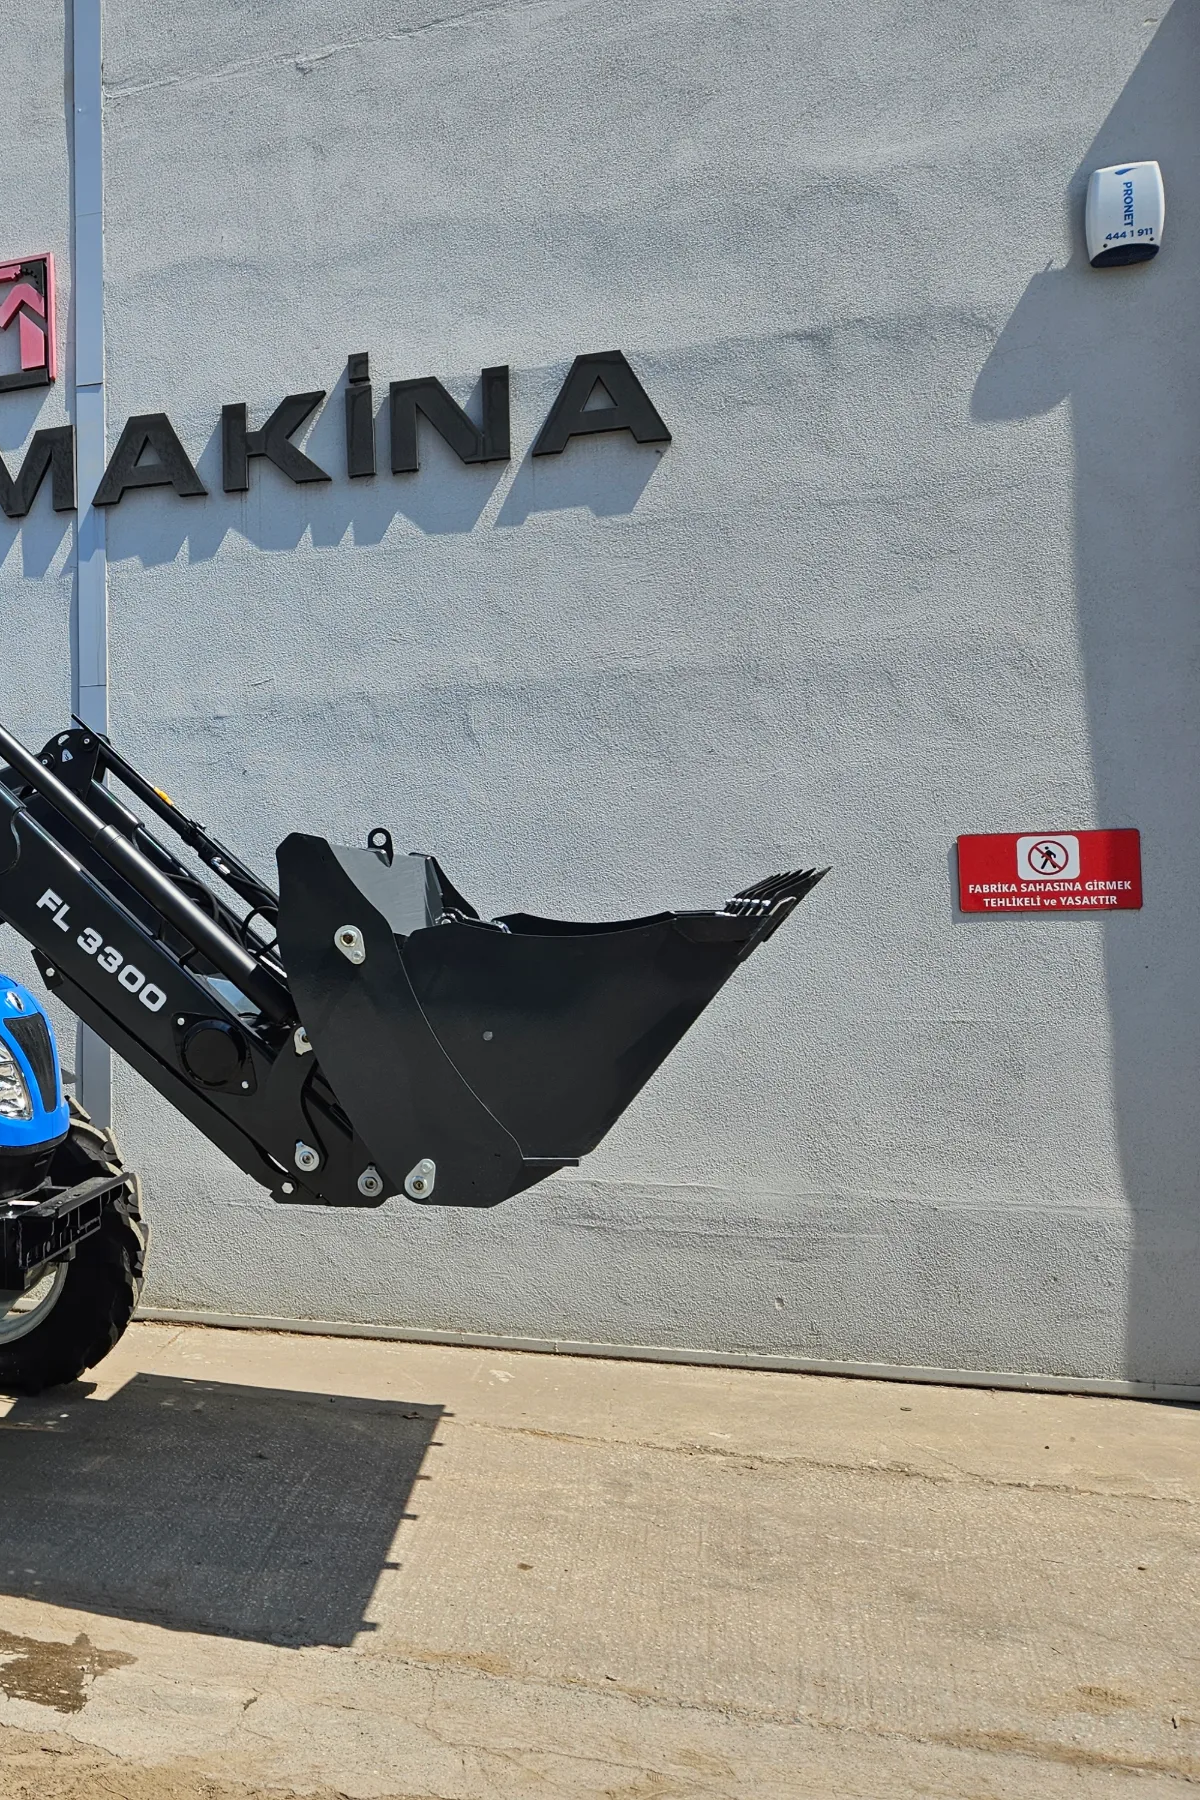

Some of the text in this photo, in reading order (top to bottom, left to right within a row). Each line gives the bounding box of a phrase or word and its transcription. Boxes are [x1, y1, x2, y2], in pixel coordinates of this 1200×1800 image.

[1123, 181, 1134, 227] PRONET
[1105, 231, 1127, 241] 444
[1137, 227, 1153, 237] 911
[968, 879, 1132, 894] FABRİKA SAHASINA GİRMEK
[983, 895, 1118, 907] TEHLİKELİ ve YASAKTIR
[36, 888, 167, 1013] FL 3300
